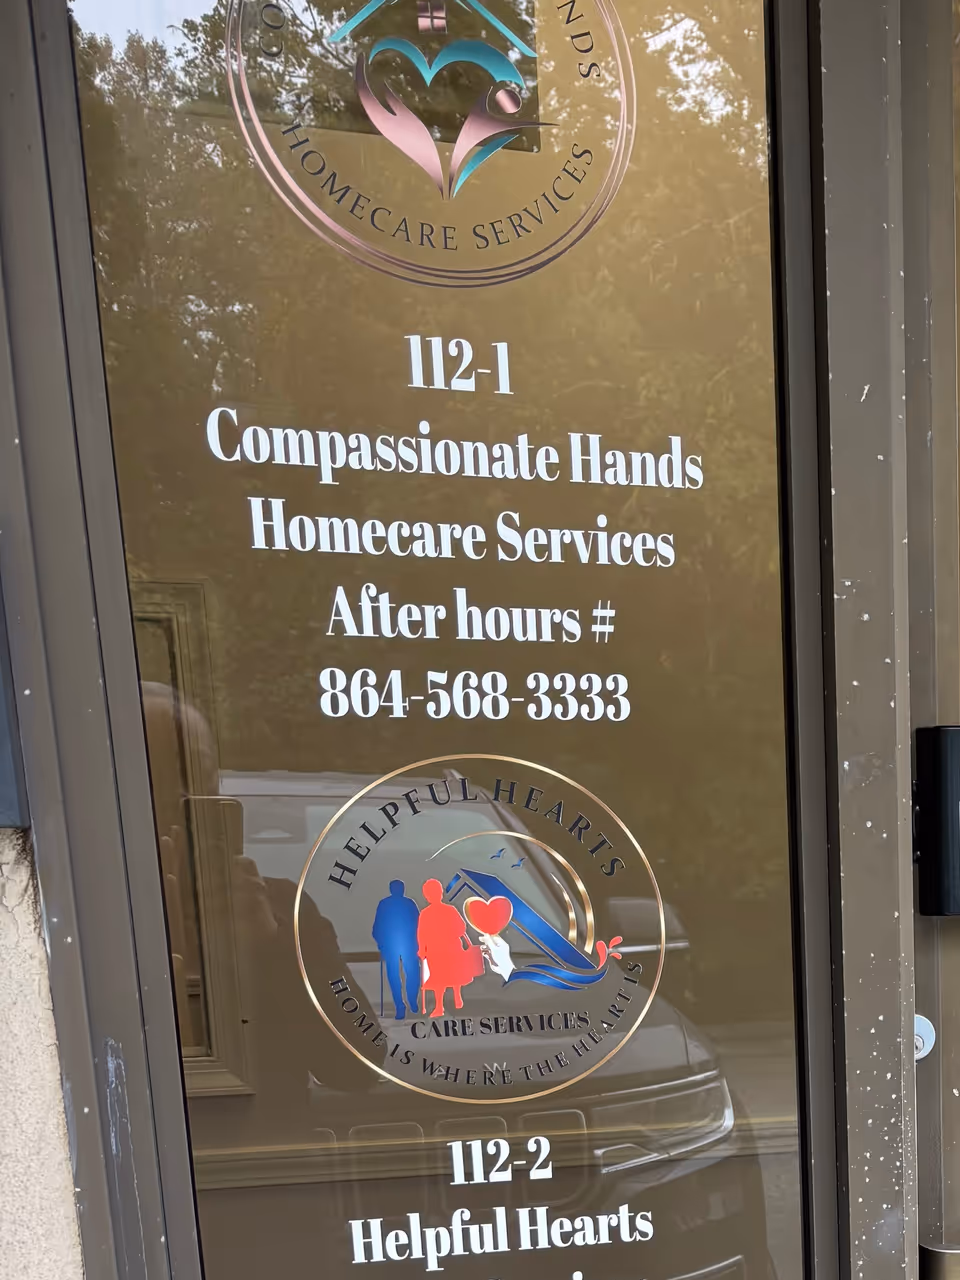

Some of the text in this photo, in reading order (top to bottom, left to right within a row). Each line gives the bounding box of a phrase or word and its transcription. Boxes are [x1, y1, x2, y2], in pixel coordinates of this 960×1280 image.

[556, 0, 601, 78] NDS
[281, 123, 594, 251] HOMECARE SERVICES
[404, 334, 515, 395] 112-1
[206, 408, 704, 490] Compassionate Hands
[247, 496, 676, 568] Homecare Services
[326, 582, 616, 643] After hours #
[318, 667, 632, 722] 864-568-3333
[327, 777, 626, 891] HELPFUL HEARTS
[328, 975, 388, 1047] HOME
[390, 1043, 415, 1065] IS
[422, 1057, 513, 1086] WHERE
[519, 1051, 570, 1081] THE
[572, 987, 633, 1057] HEART
[624, 960, 643, 987] IS
[410, 1011, 591, 1040] CARE SERVICES
[446, 1136, 553, 1185] 112-2
[348, 1203, 654, 1272] Helpful Hearts
